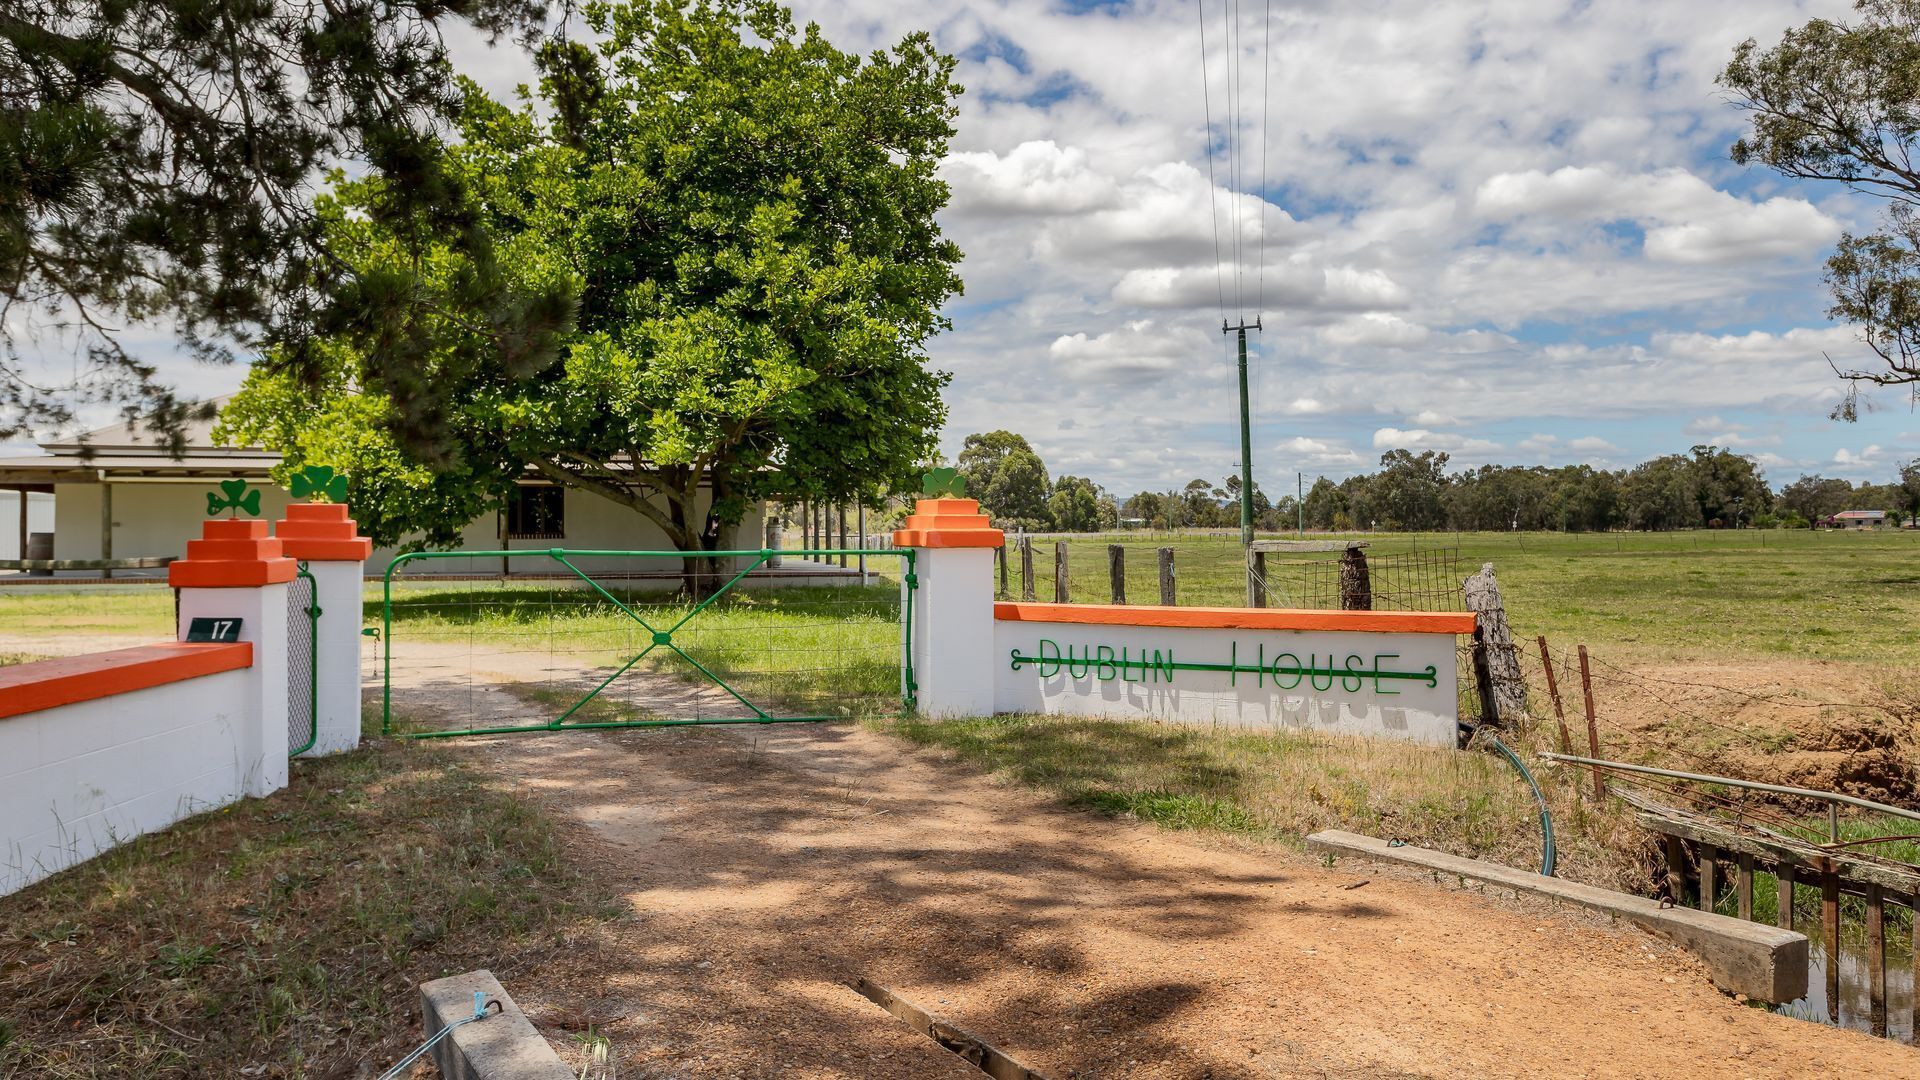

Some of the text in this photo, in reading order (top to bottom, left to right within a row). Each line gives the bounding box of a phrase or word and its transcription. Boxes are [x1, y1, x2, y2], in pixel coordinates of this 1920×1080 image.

[211, 621, 233, 639] 17
[1039, 639, 1401, 694] DUBLIN HOUSE
